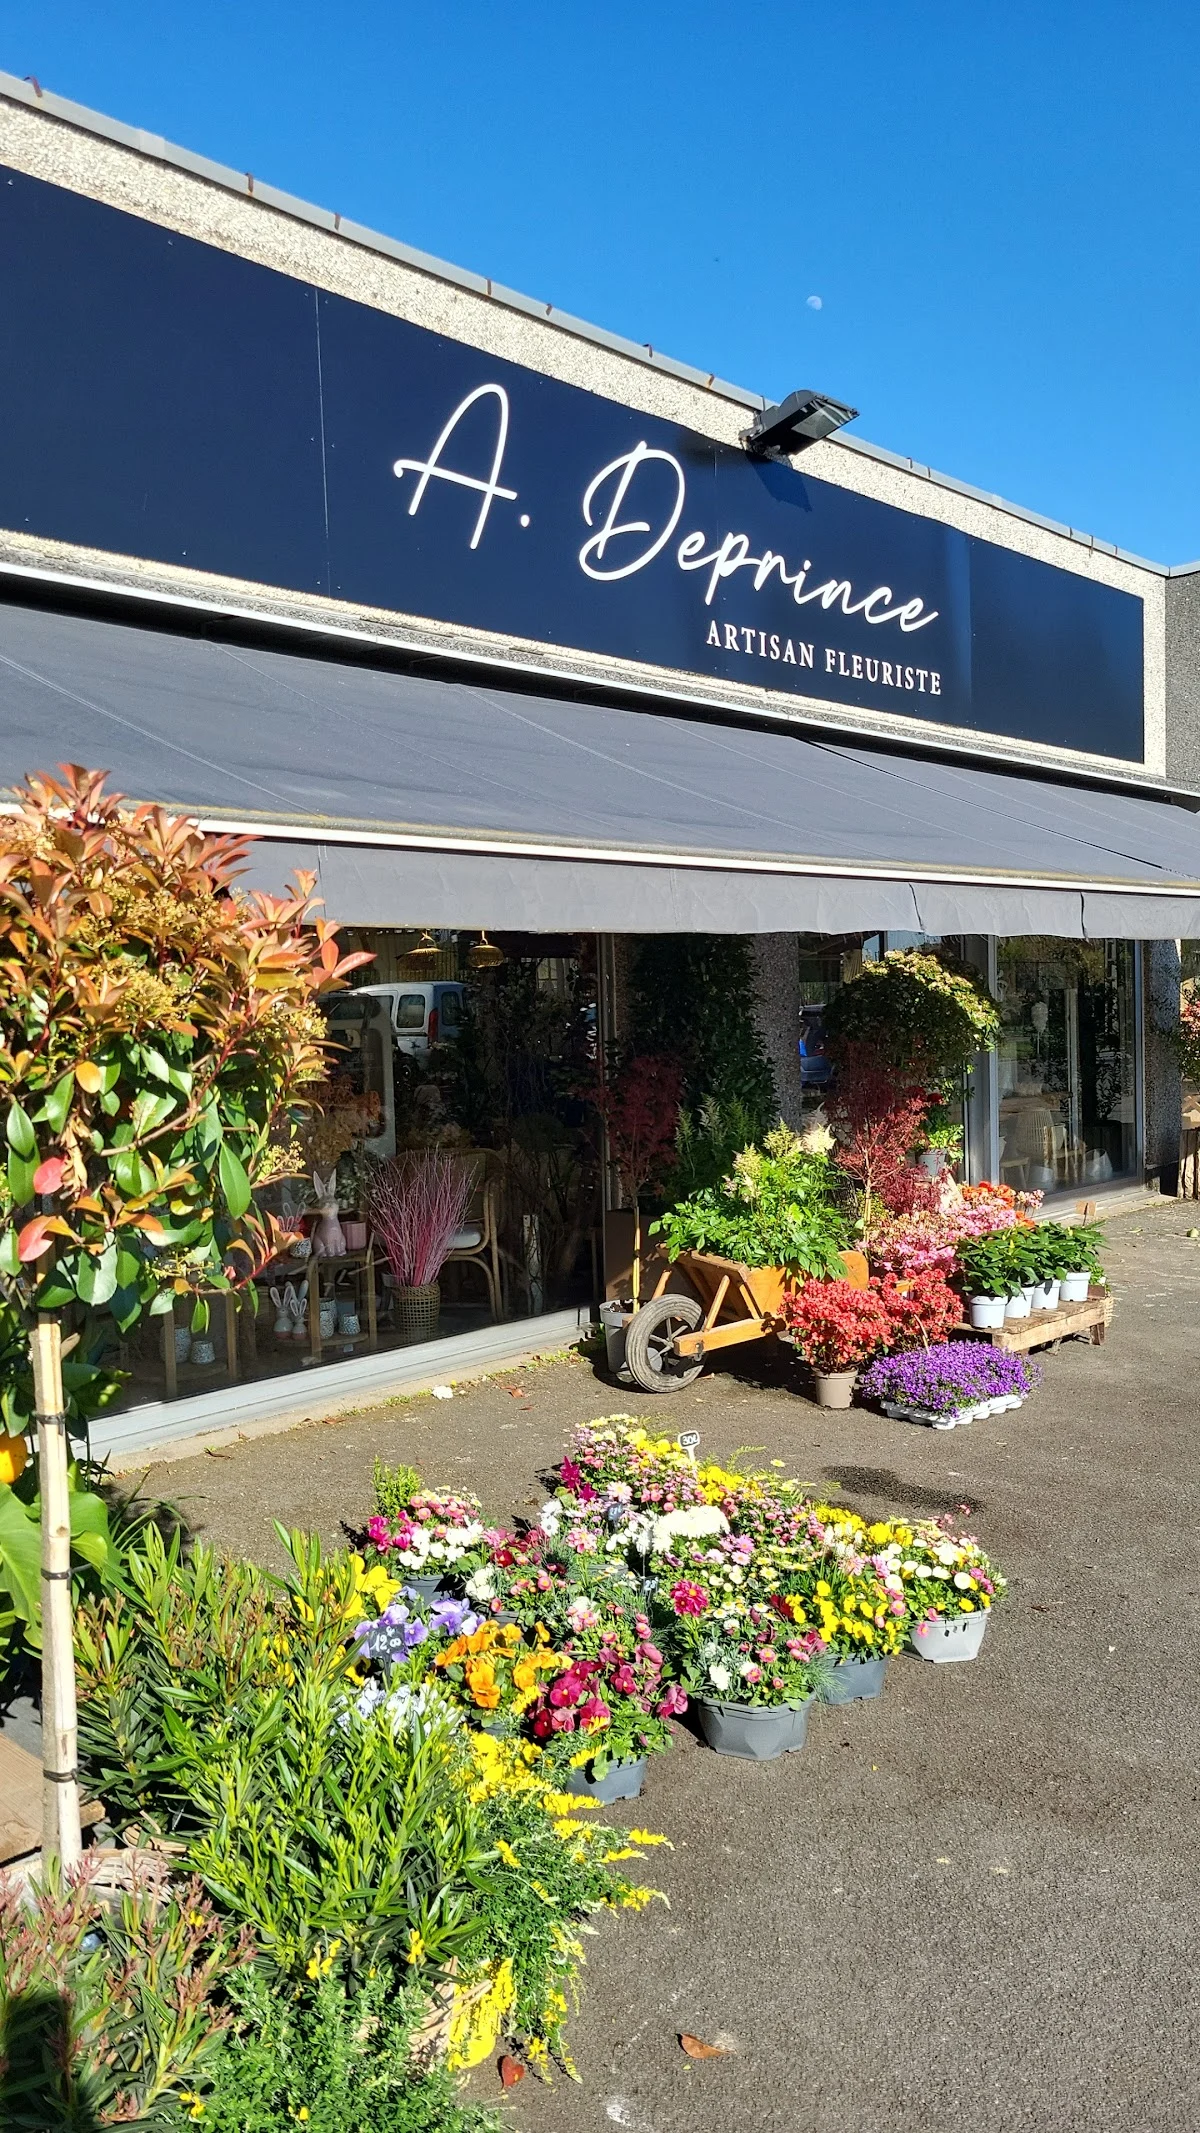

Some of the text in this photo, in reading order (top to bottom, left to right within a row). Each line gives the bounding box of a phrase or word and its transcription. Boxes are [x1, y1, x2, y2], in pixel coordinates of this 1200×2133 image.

[393, 383, 939, 632] A. Deprince
[706, 620, 941, 696] ARTISAN FLEURISTE
